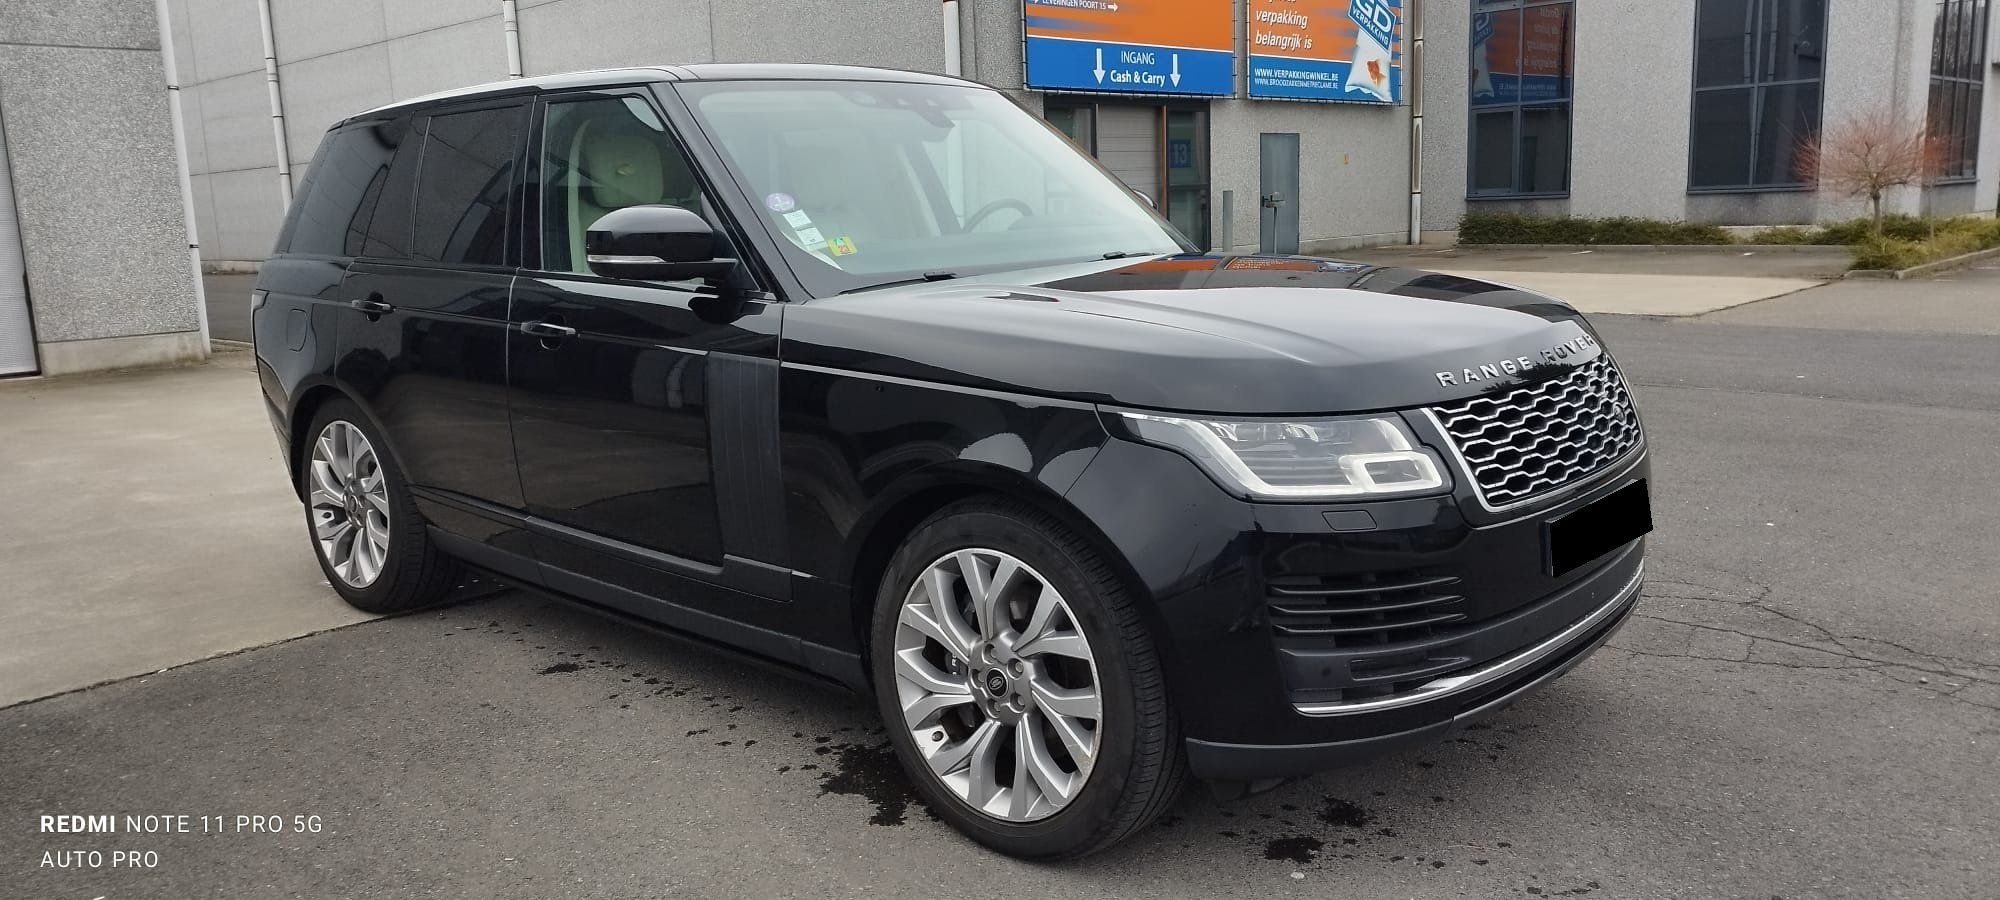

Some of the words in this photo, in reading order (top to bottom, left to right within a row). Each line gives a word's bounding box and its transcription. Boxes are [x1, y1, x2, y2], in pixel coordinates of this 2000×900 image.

[1079, 0, 1098, 9] POORT
[1255, 9, 1308, 29] verpakking
[1352, 5, 1389, 46] VERPAKKING
[1355, 0, 1392, 33] GD
[1255, 30, 1301, 50] belangrijk
[1304, 34, 1313, 49] is
[1120, 51, 1155, 65] INGANG
[1110, 69, 1132, 83] Cash
[1133, 70, 1141, 83] &
[1141, 71, 1166, 88] Carry
[1254, 68, 1339, 82] WWW.VERPAKKINGWINKEL.BE
[1435, 356, 1534, 387] RANGE
[1540, 333, 1596, 364] ROVER
